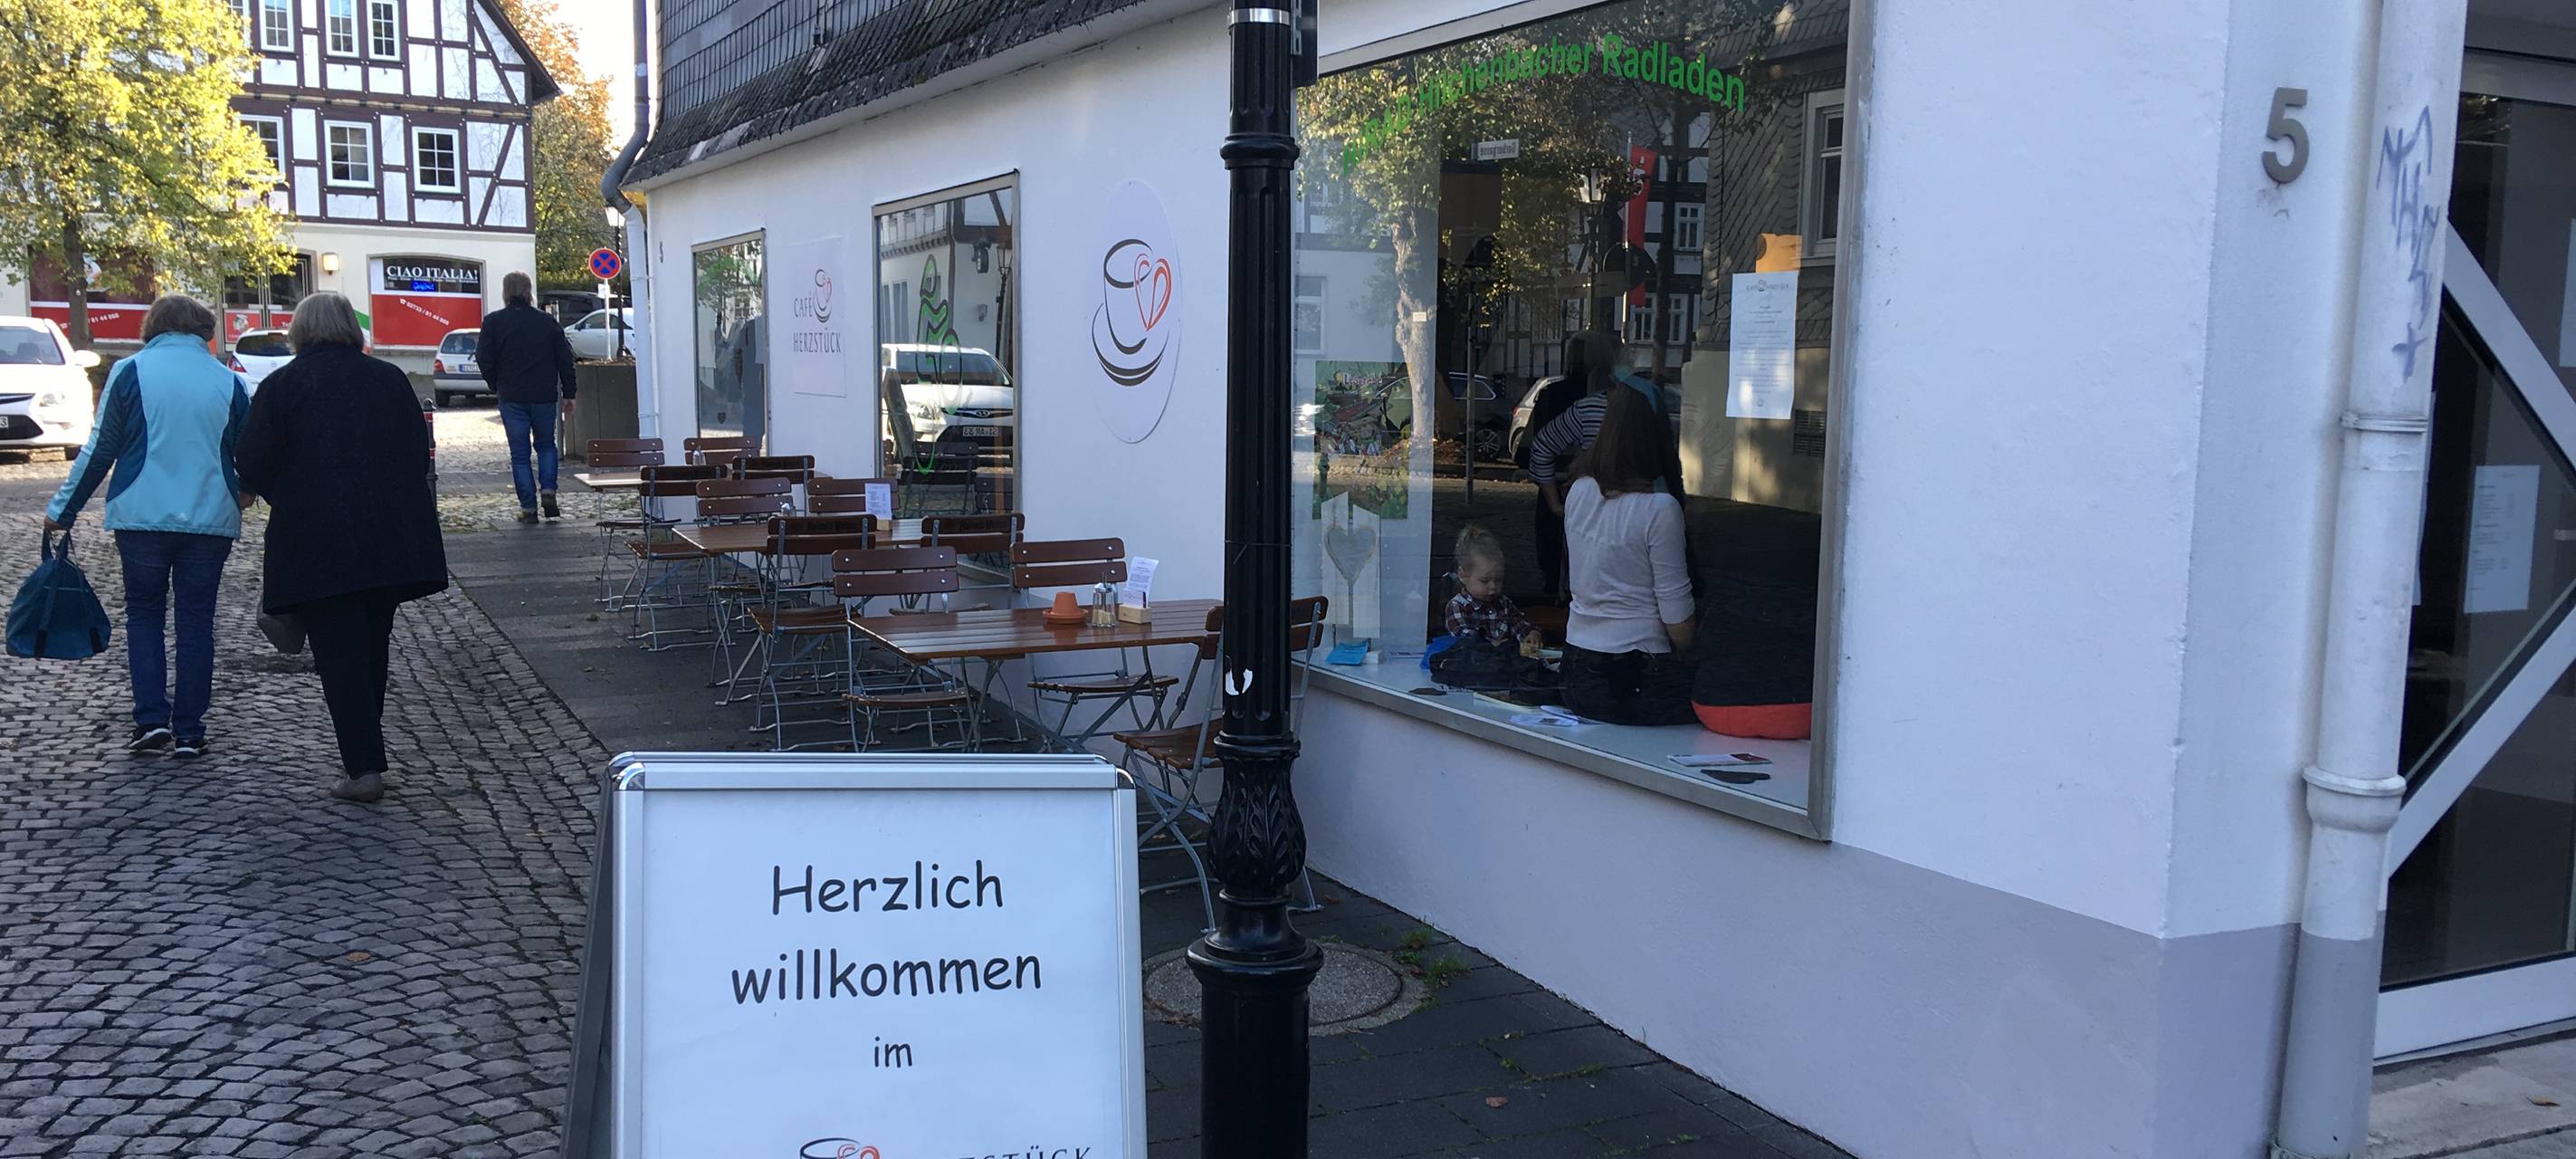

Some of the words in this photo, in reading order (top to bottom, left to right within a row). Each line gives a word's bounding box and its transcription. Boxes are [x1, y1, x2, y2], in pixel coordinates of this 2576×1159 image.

[1418, 34, 1594, 117] Hilchenbacher
[1603, 34, 1745, 112] Radladen
[2262, 87, 2310, 183] 5
[386, 265, 423, 278] CIAO
[426, 267, 478, 280] ITALIA!
[794, 291, 813, 318] CAFÉ
[793, 327, 841, 354] HERZSTÜCK
[772, 859, 1004, 915] Herzlich
[731, 947, 1042, 1005] willkommen
[873, 1036, 913, 1068] im
